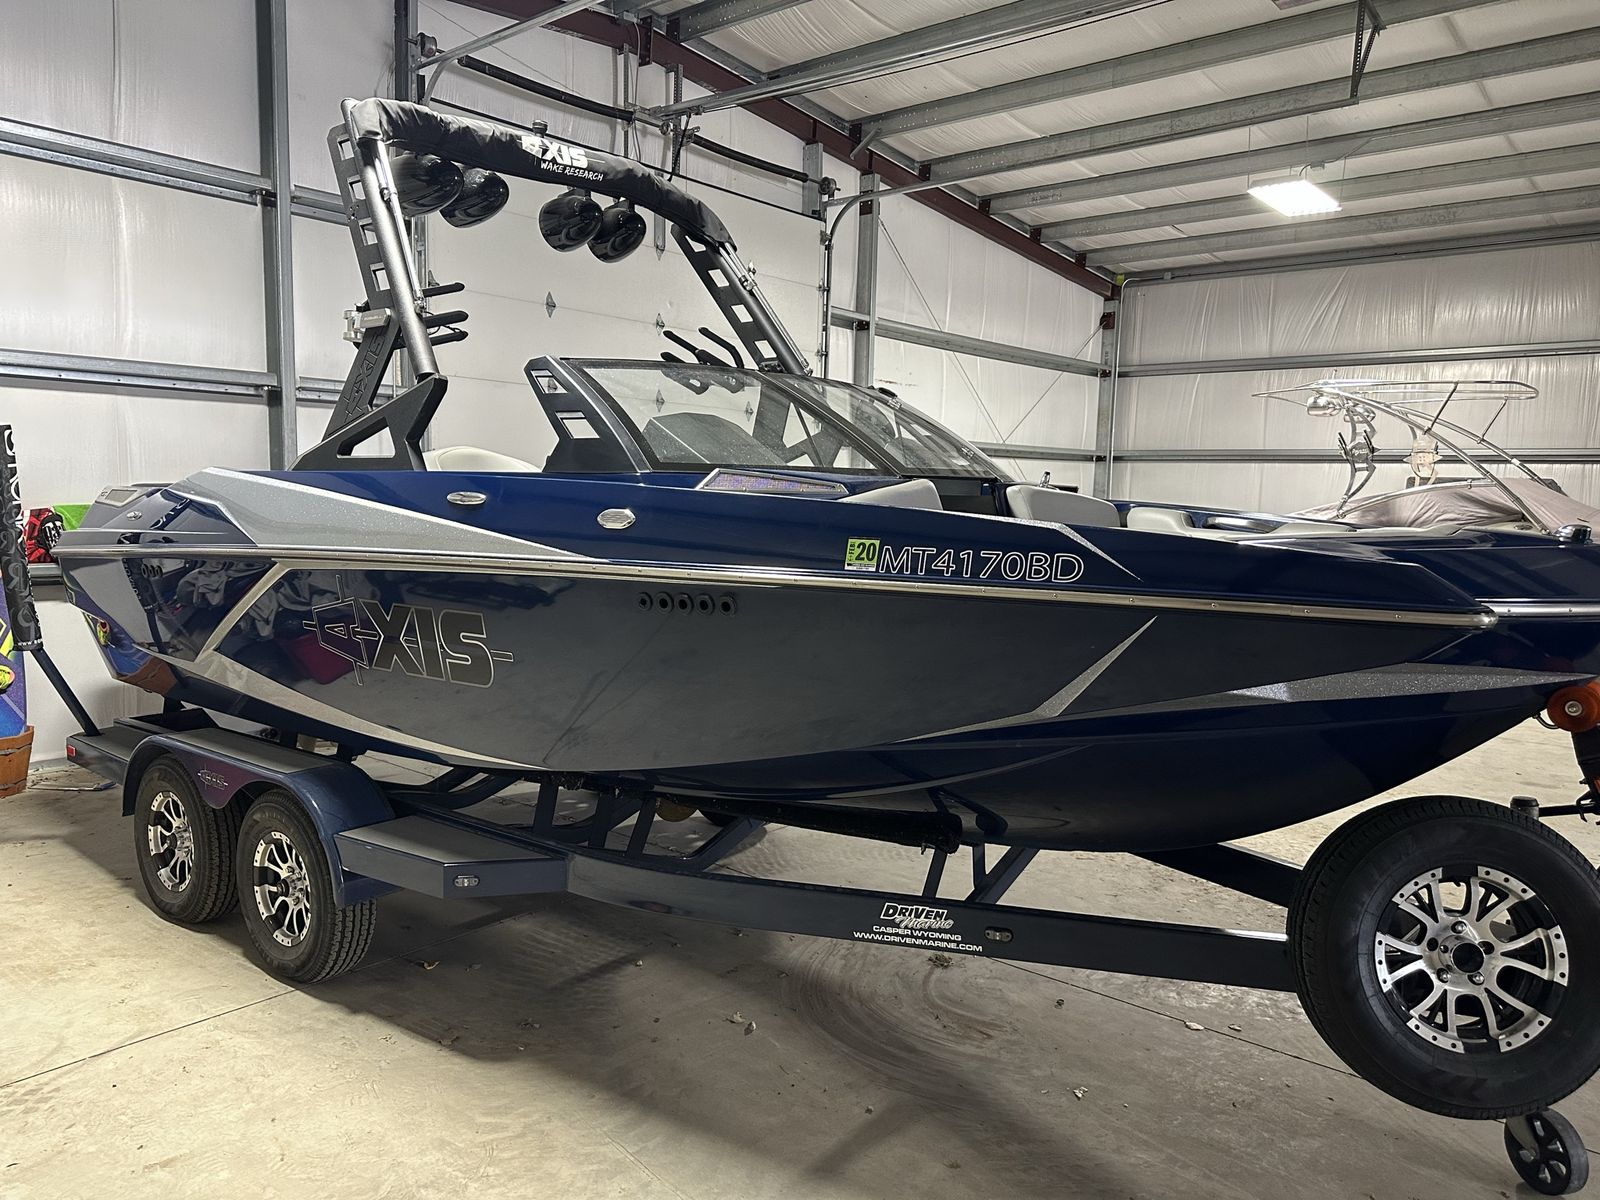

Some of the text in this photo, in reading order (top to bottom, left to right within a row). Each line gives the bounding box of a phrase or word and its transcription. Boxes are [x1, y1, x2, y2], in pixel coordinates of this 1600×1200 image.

[541, 161, 604, 181] WAKE RESEARCH
[855, 541, 877, 562] 20
[879, 545, 1084, 583] MT4170BD
[309, 594, 496, 688] AXIS
[880, 902, 947, 921] DRIVEN
[853, 931, 983, 952] WWW.DRIVENMARINE.COM
[872, 925, 962, 942] CASPER WYOMING
